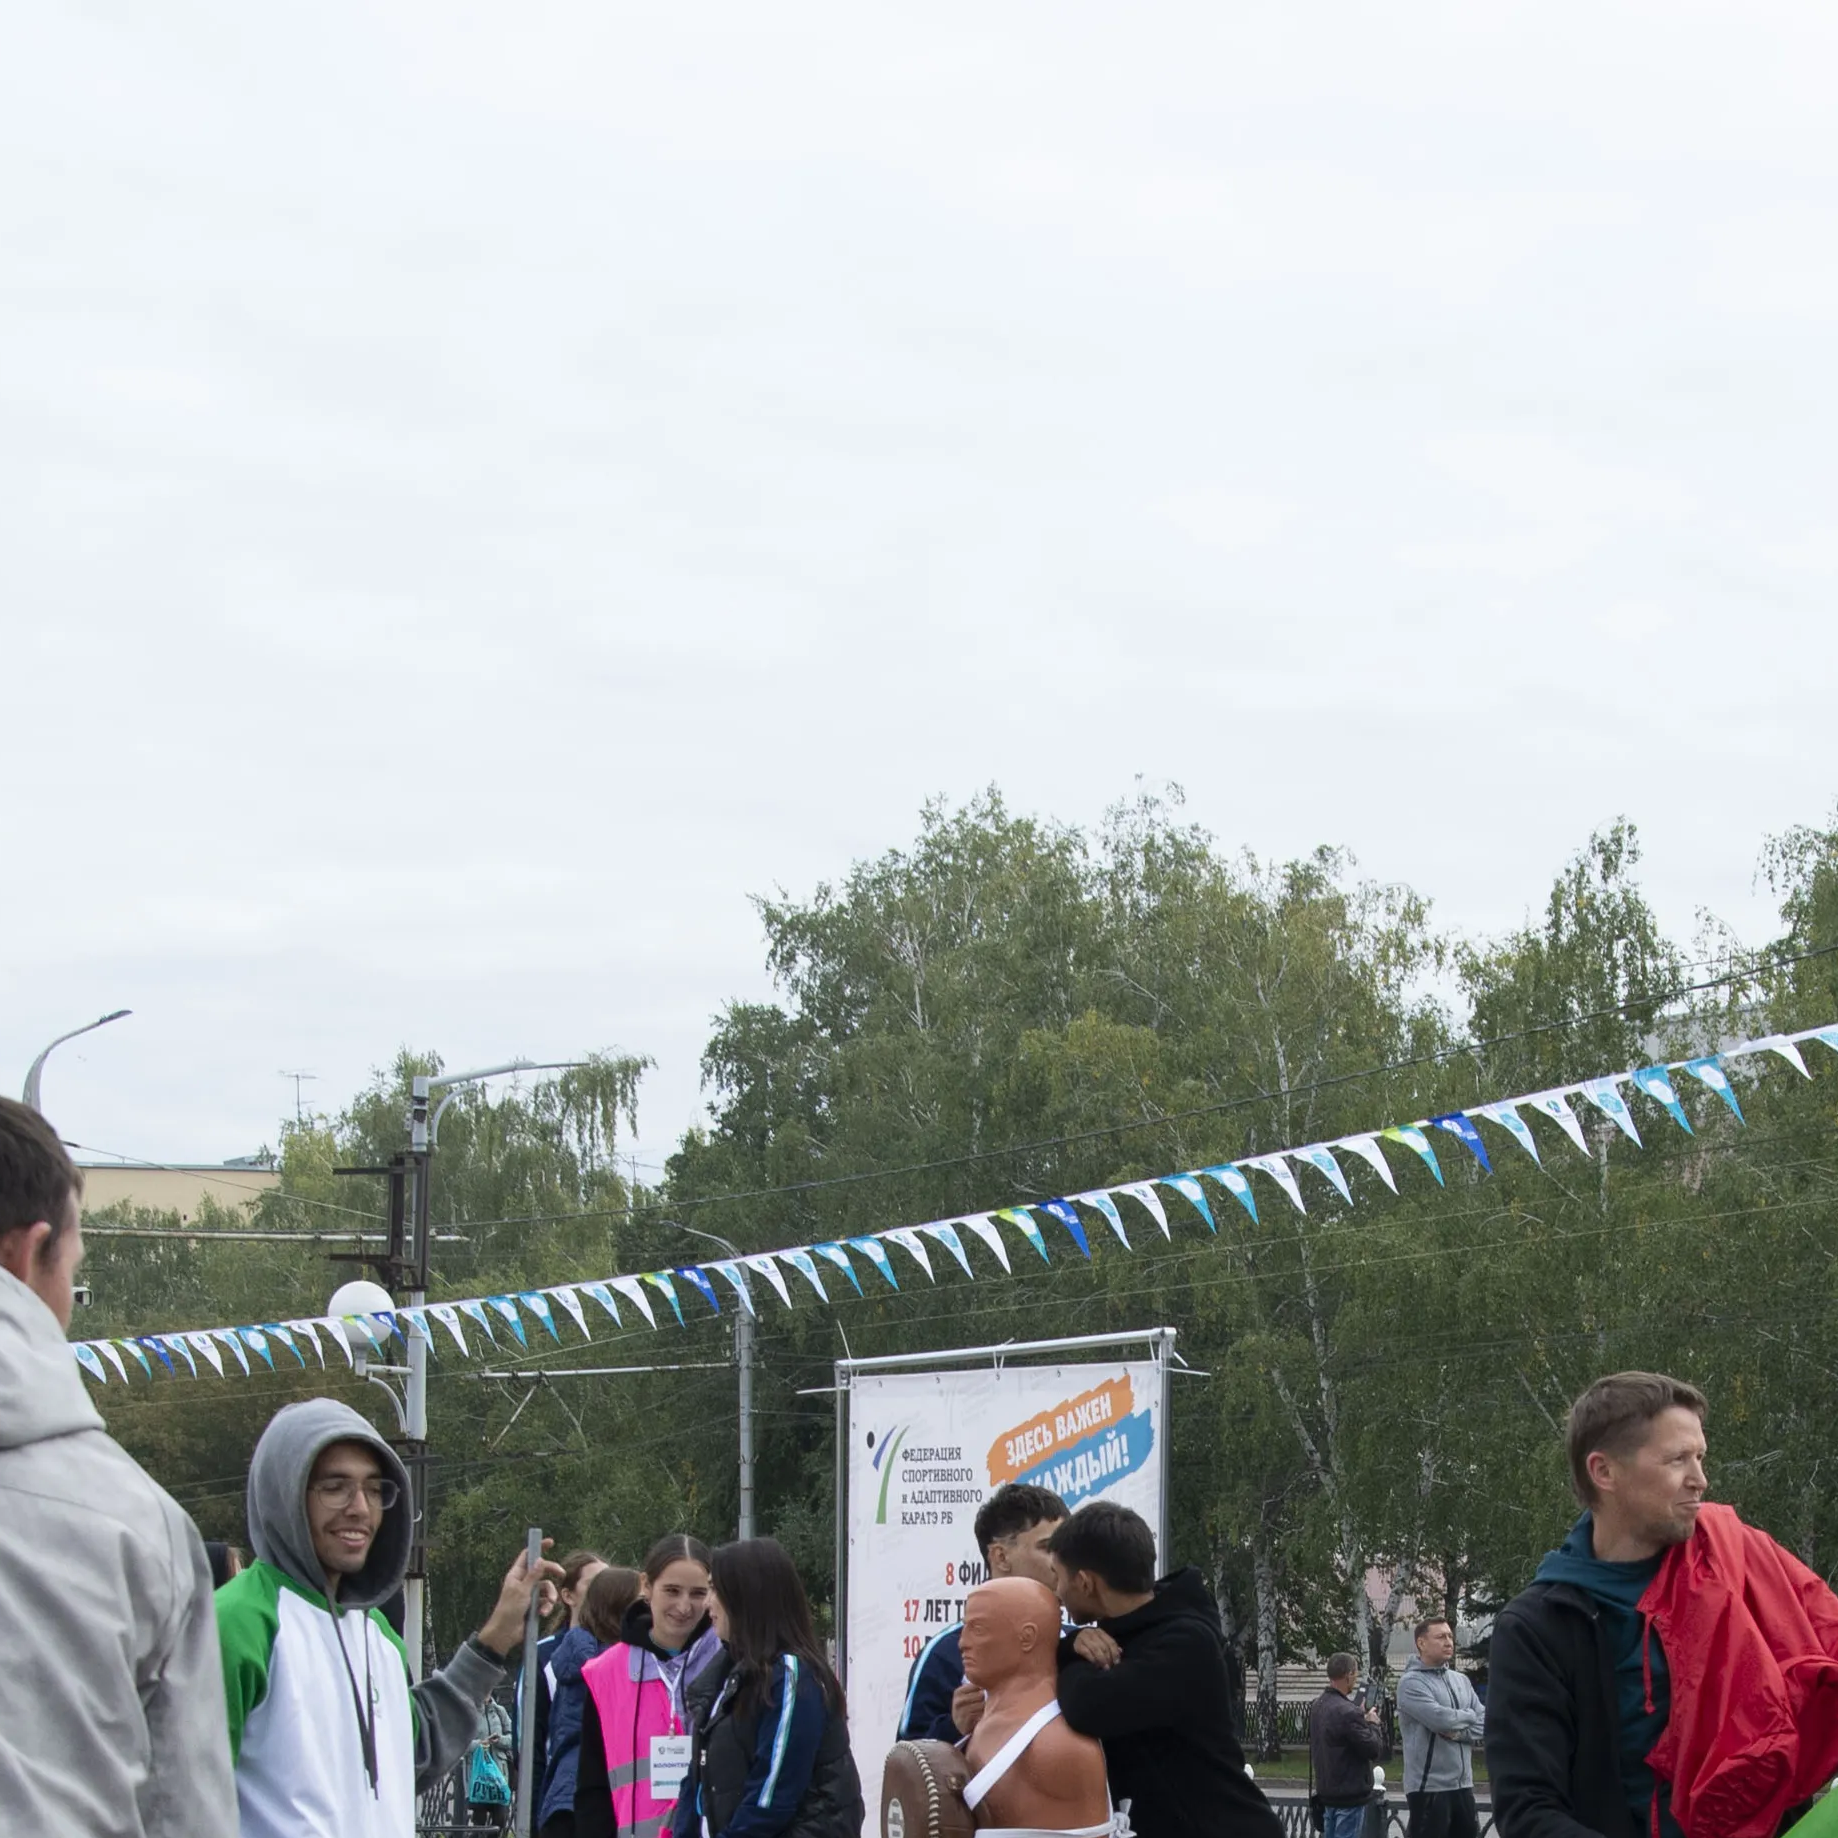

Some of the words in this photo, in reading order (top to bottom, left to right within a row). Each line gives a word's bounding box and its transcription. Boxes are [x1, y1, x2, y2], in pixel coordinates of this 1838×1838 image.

[1005, 1423, 1053, 1467] ЗДЕСЬ
[1055, 1392, 1112, 1442] ВАЖЕН
[901, 1446, 962, 1463] ФЕДЕРАЦИЯ
[901, 1467, 973, 1483] СПОРТИВНОГО
[910, 1488, 983, 1505] АДАПТИВНОГО
[901, 1511, 938, 1525] КАРАТЭ
[940, 1511, 953, 1525] РБ
[945, 1562, 955, 1586] 8
[904, 1599, 920, 1622] 17
[923, 1599, 952, 1623] ЛЕТ
[903, 1634, 921, 1659] 10
